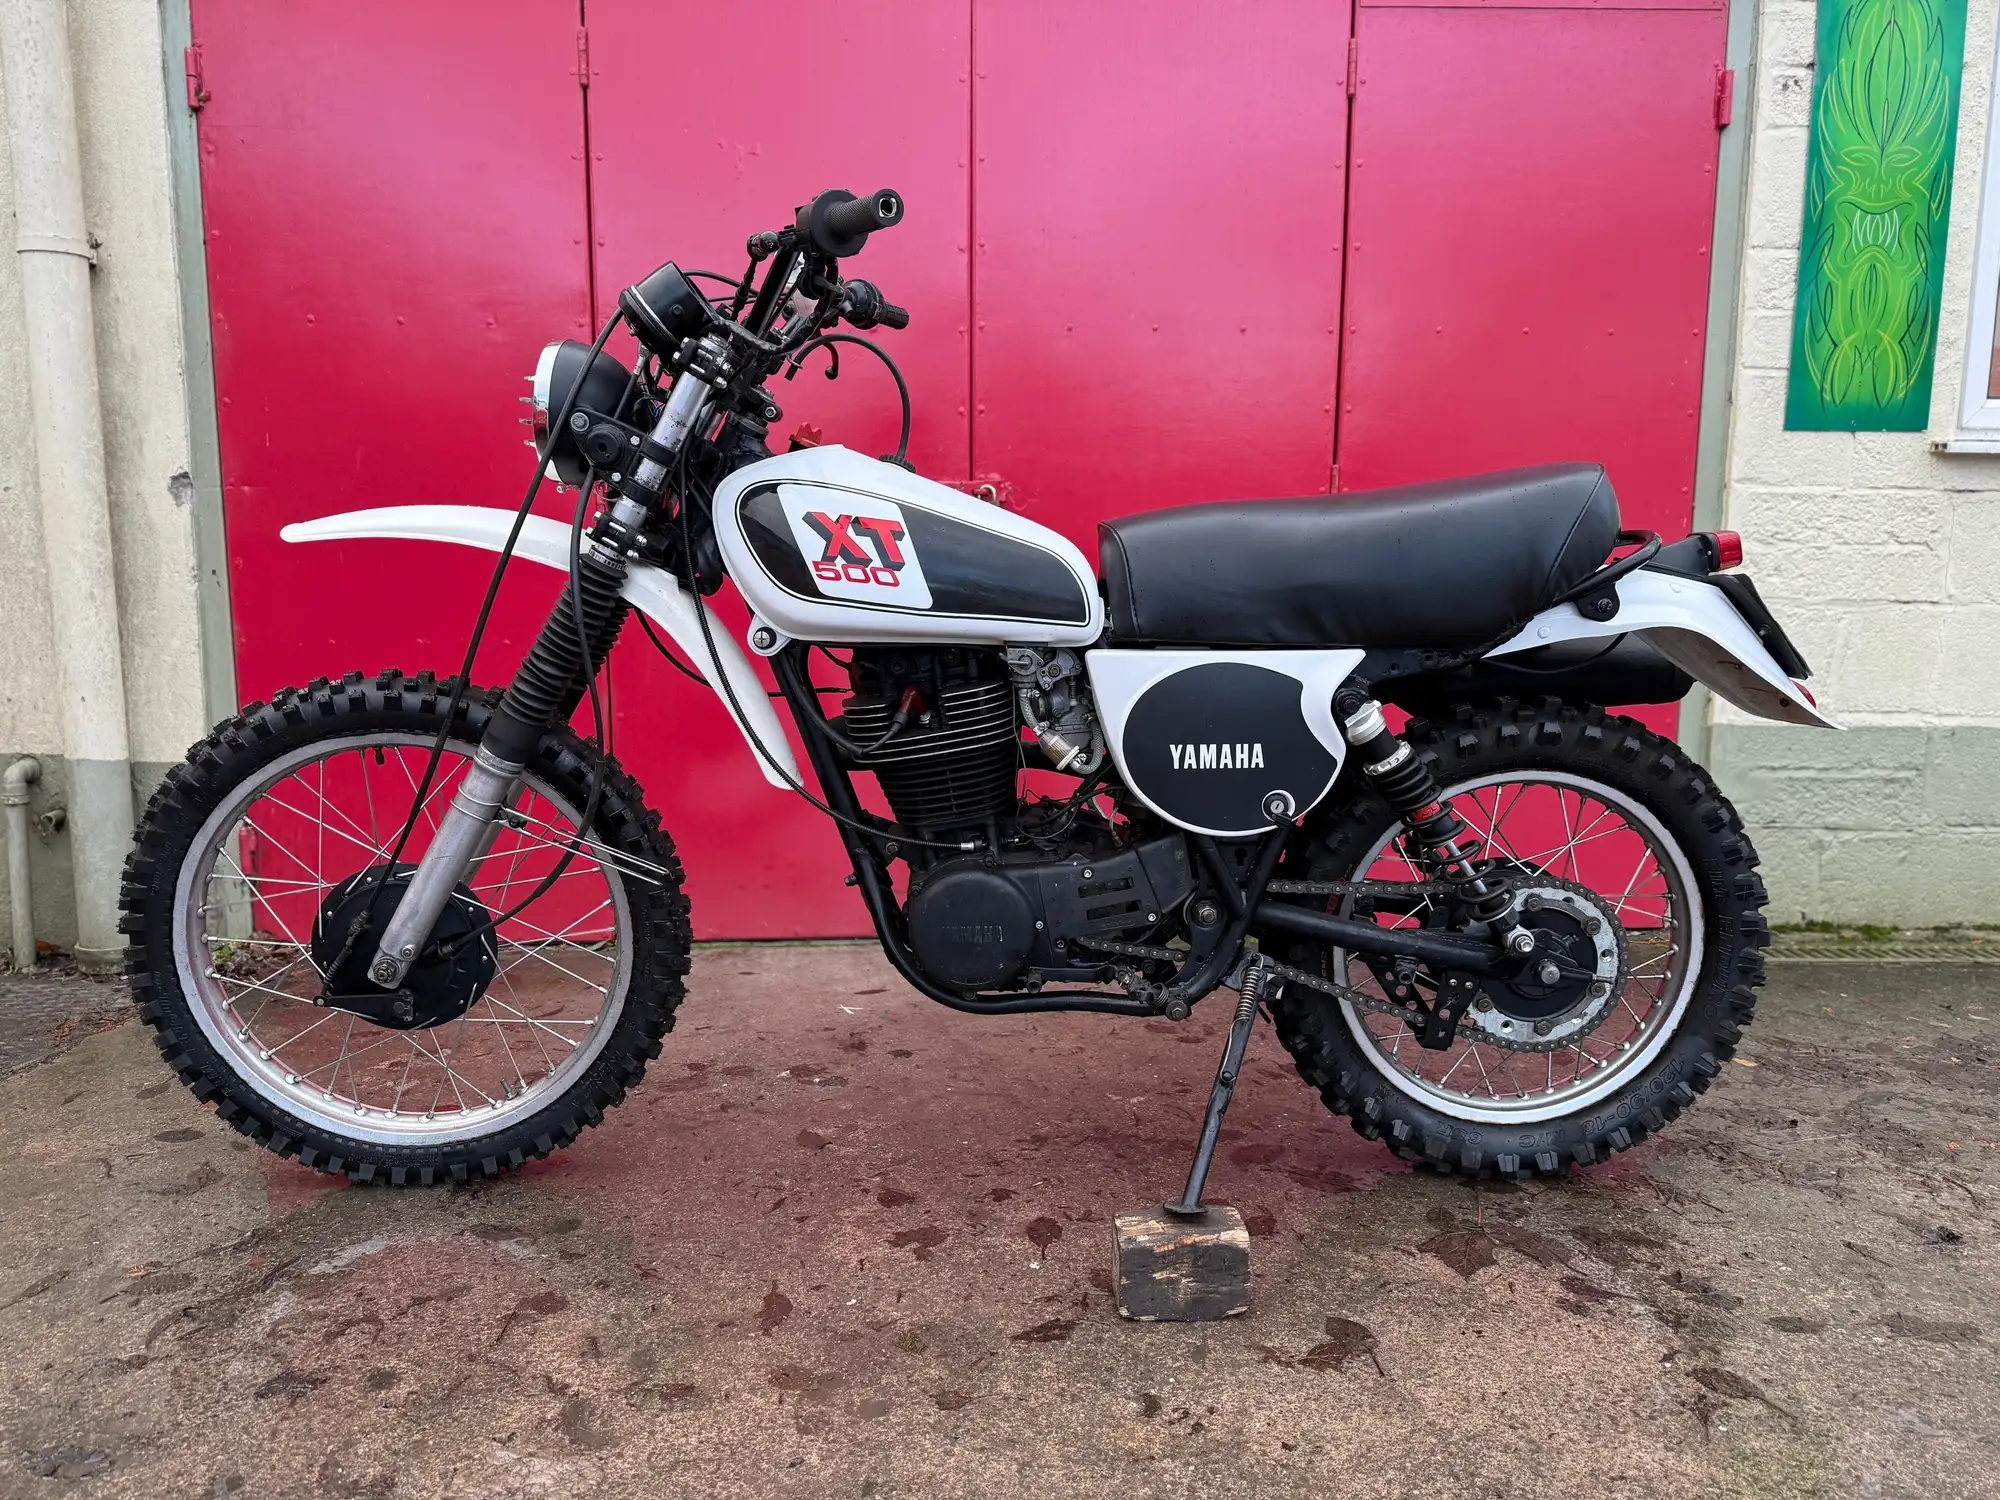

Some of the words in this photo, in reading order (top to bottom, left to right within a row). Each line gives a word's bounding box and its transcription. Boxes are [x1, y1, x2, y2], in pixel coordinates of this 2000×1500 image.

[802, 511, 906, 571] XT
[812, 560, 901, 588] 500
[1169, 743, 1265, 770] YAMAHA
